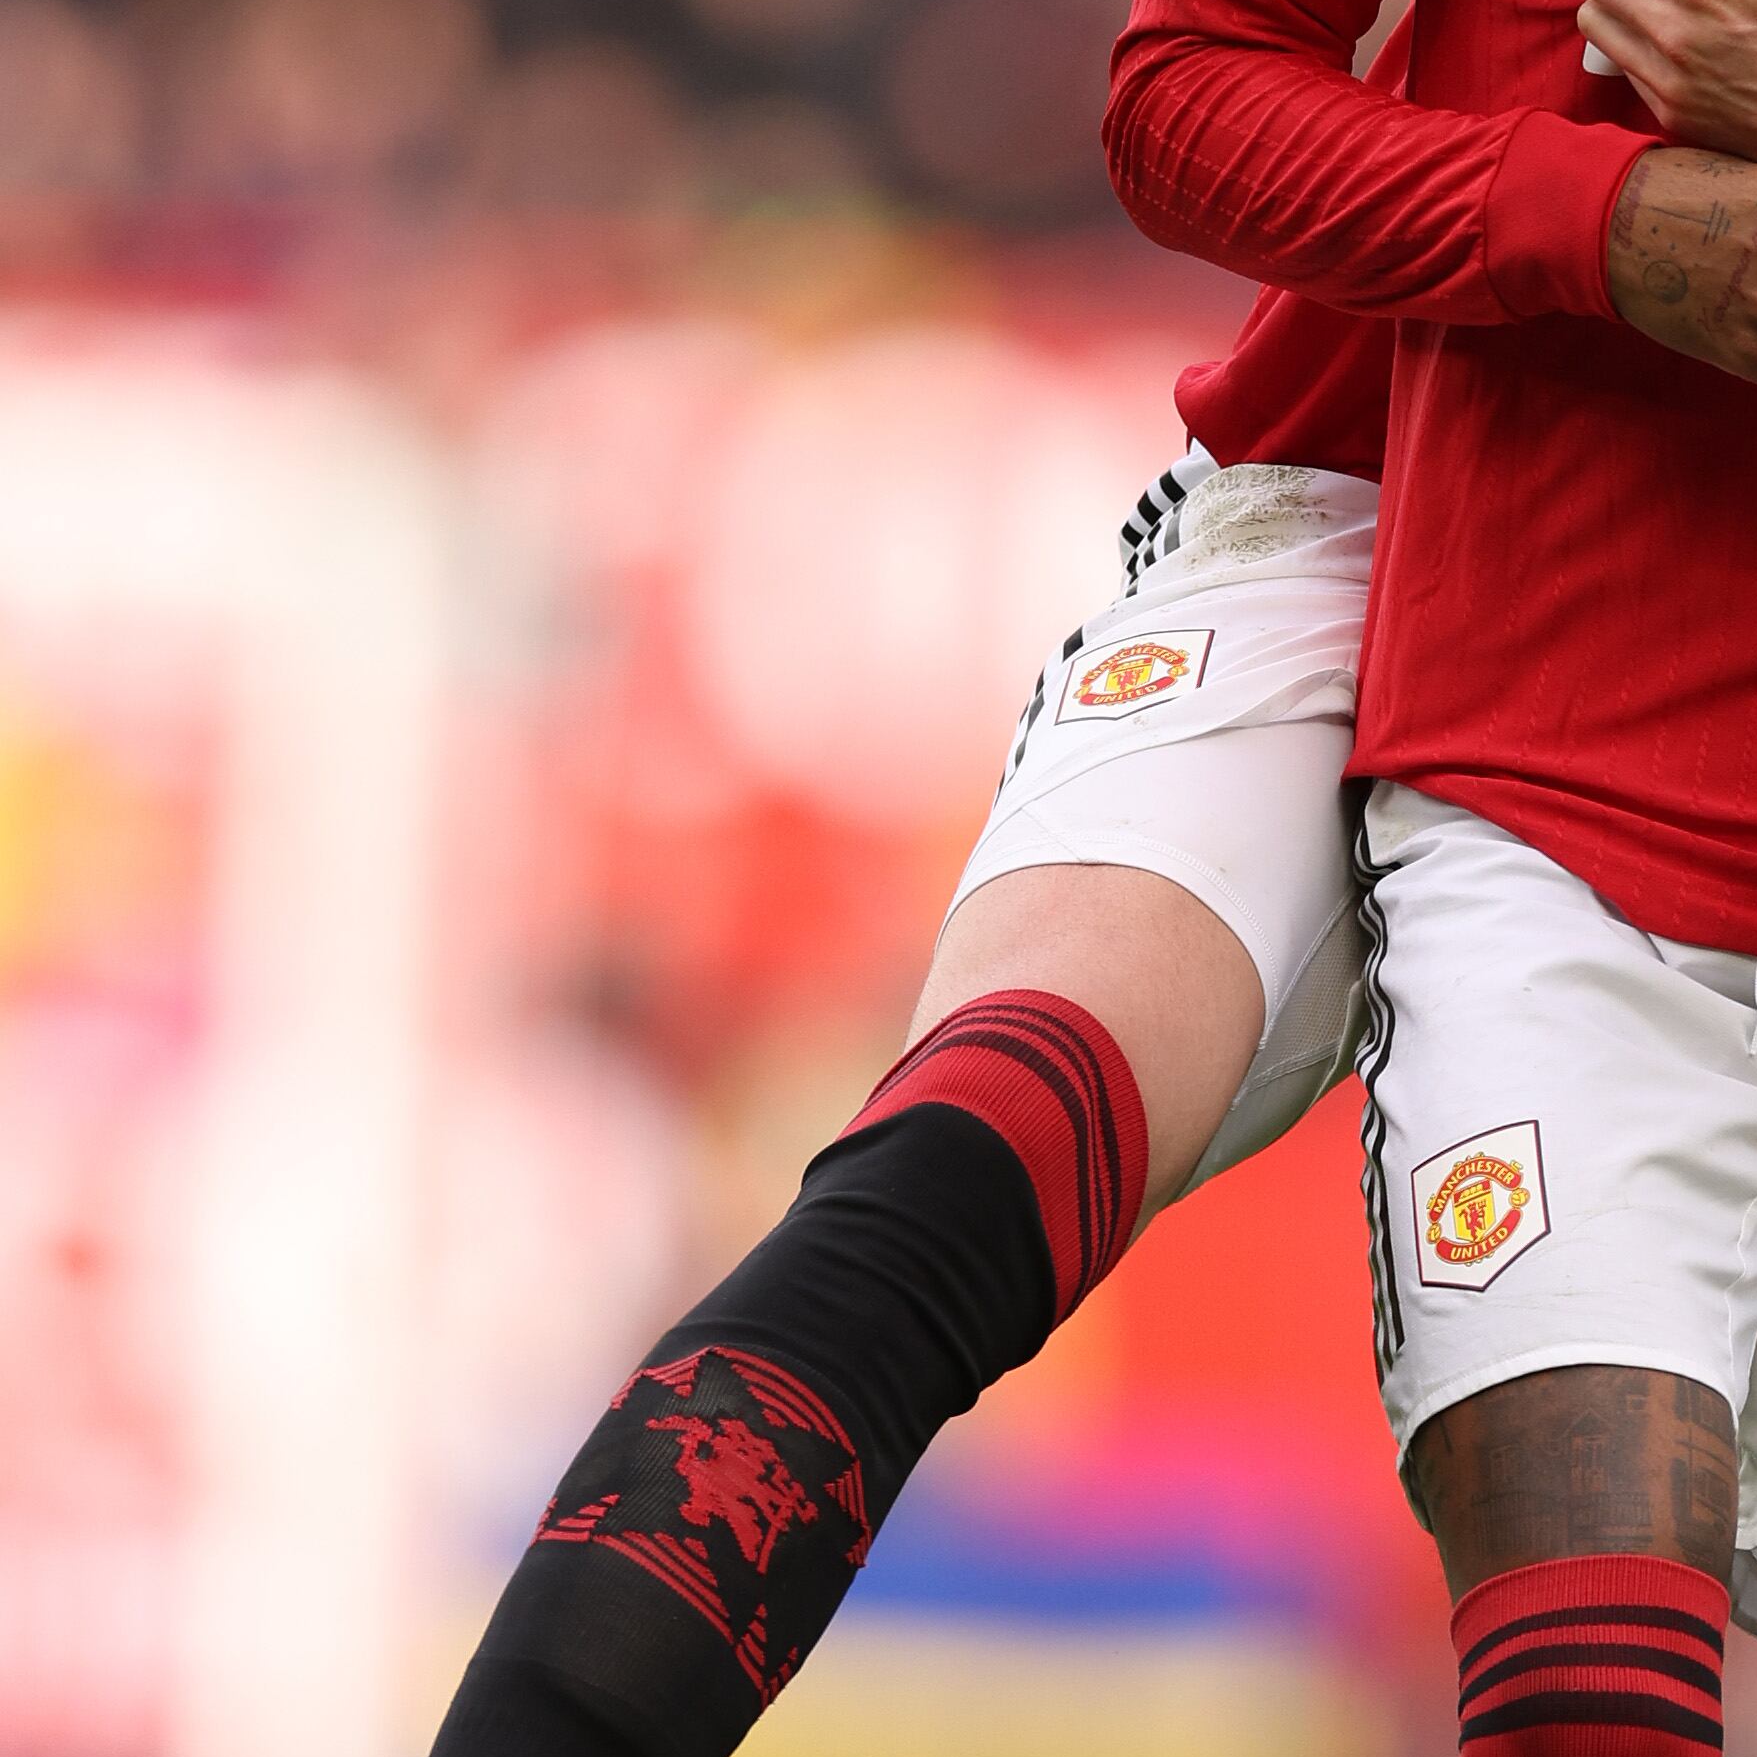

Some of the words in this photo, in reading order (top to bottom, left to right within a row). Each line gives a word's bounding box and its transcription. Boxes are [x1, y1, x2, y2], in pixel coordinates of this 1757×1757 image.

[1092, 684, 1158, 705] UNITED
[1433, 1160, 1515, 1215] MANCHESTER
[1450, 1226, 1509, 1261] UNITED
